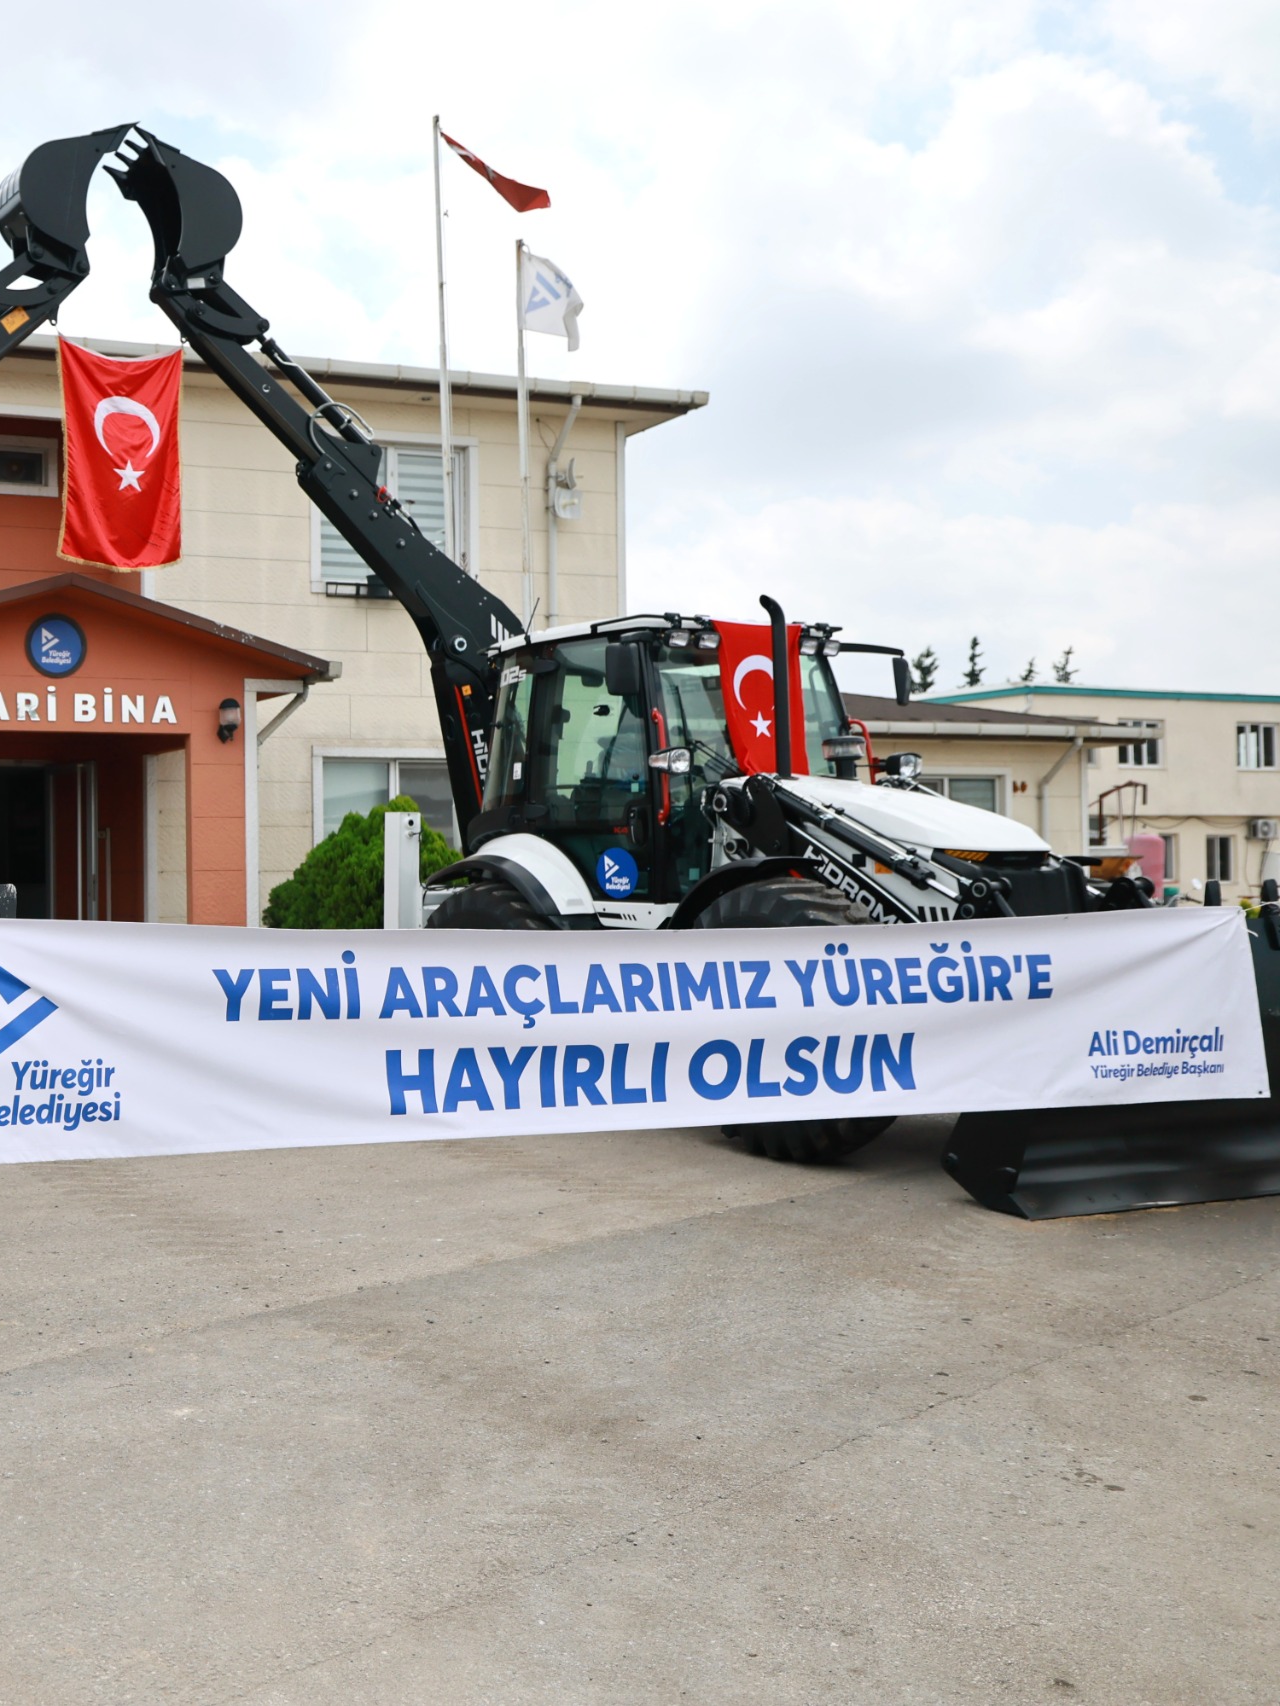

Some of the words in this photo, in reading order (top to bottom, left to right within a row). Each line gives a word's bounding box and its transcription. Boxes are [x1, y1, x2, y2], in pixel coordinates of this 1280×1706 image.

[74, 687, 178, 724] BİNA
[212, 950, 361, 1022] YENİ
[380, 961, 777, 1029] ARAÇLARIMIZ
[784, 941, 1053, 1007] YÜREĞİR'E
[1088, 1030, 1119, 1057] Ali
[1123, 1026, 1224, 1058] Demirçalı
[11, 1058, 115, 1096] Yüreğir
[386, 1042, 669, 1115] HAYIRLI
[689, 1033, 916, 1100] OLSUN
[1090, 1064, 1135, 1081] Yüreğir
[1136, 1062, 1179, 1079] Belediye
[1181, 1060, 1225, 1078] Başkanı
